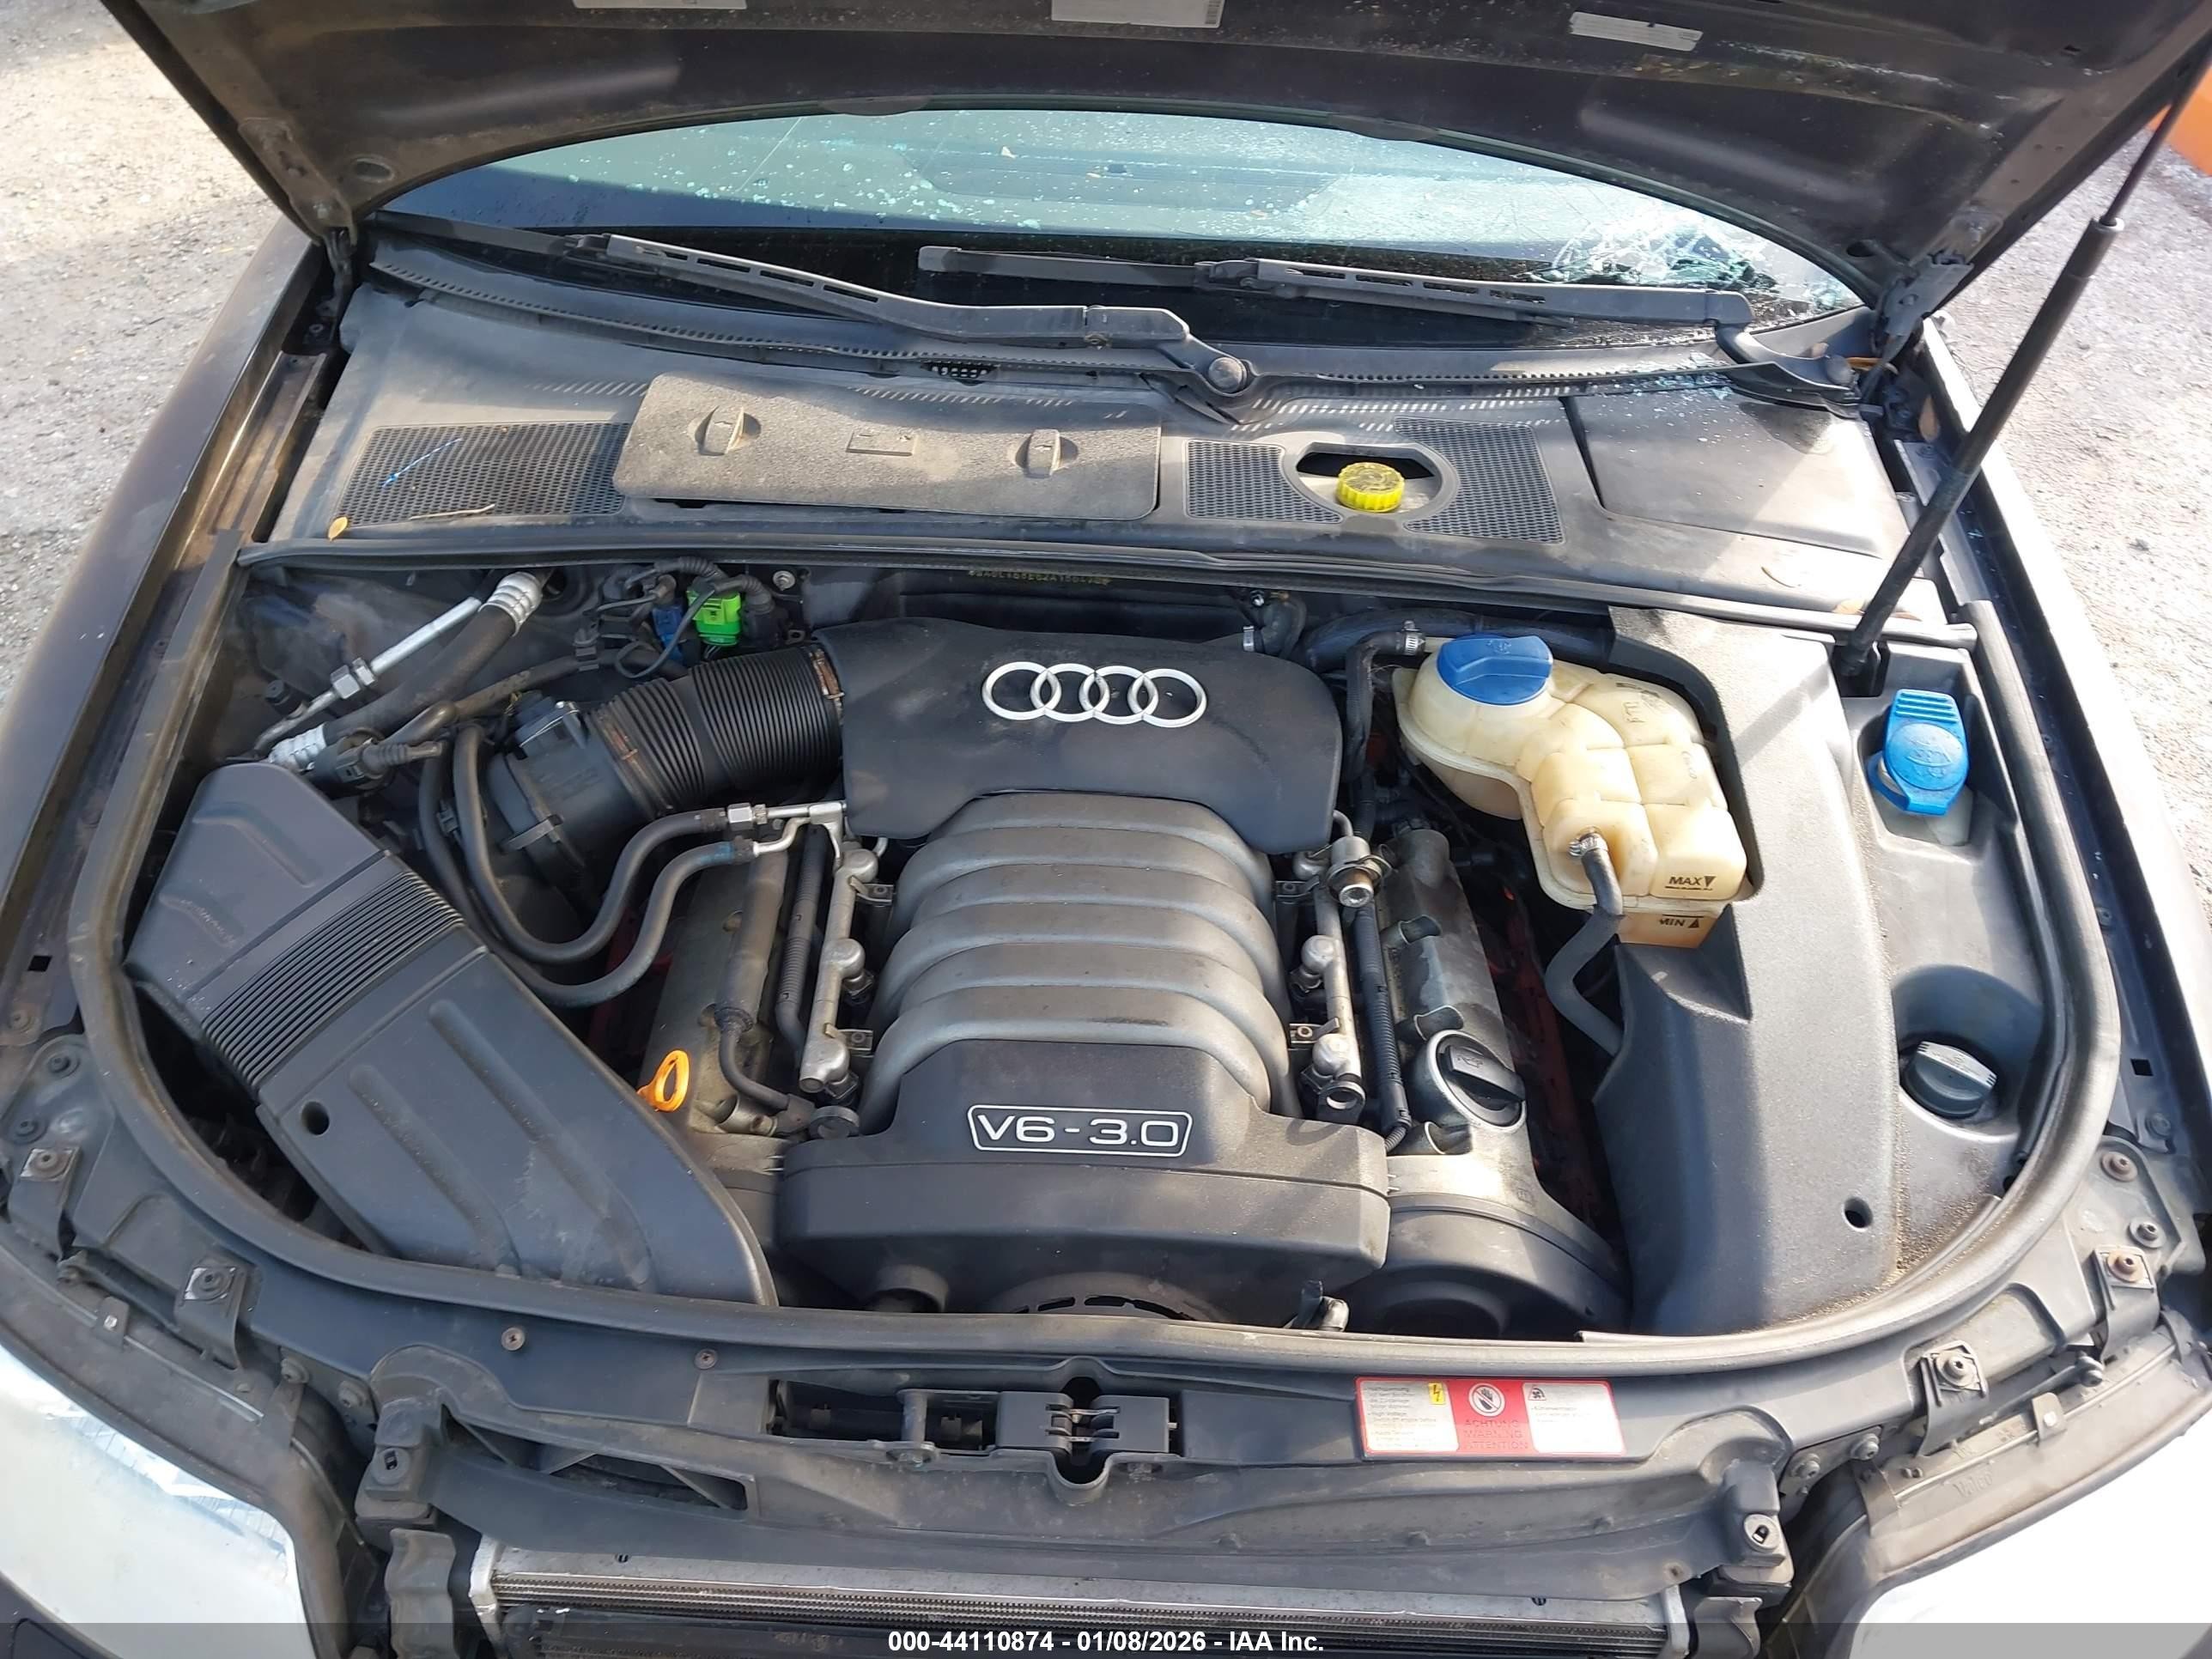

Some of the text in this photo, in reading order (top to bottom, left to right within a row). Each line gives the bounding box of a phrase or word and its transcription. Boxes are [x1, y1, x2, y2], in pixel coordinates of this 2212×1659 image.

[1668, 876, 1702, 886] MAX
[1464, 1419, 1519, 1428] ACHTUNG
[1463, 1429, 1522, 1438] WARNING
[1465, 1440, 1528, 1449] ATTENTION
